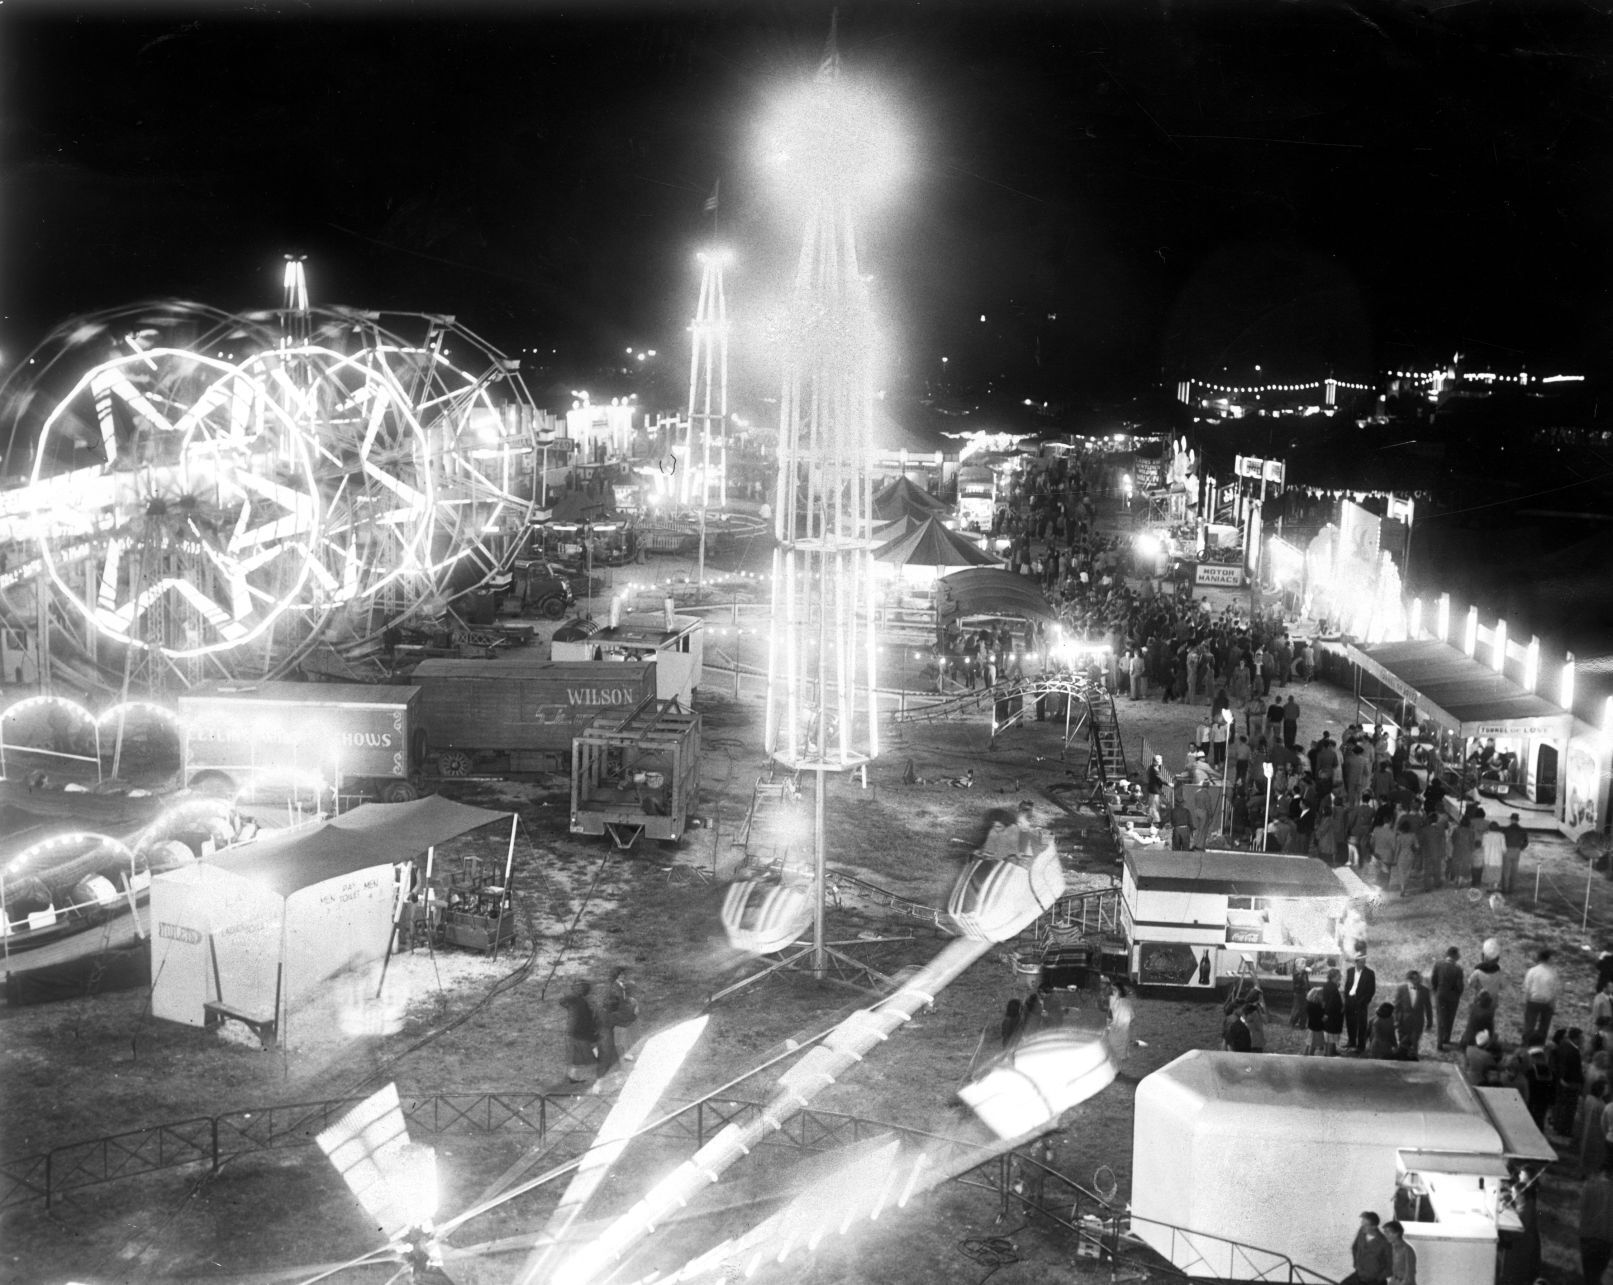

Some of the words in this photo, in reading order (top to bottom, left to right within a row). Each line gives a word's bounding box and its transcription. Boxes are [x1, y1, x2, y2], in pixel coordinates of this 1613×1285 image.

[1198, 576, 1238, 584] MANIACS
[567, 688, 633, 706] WILSON
[337, 731, 392, 748] HOWS
